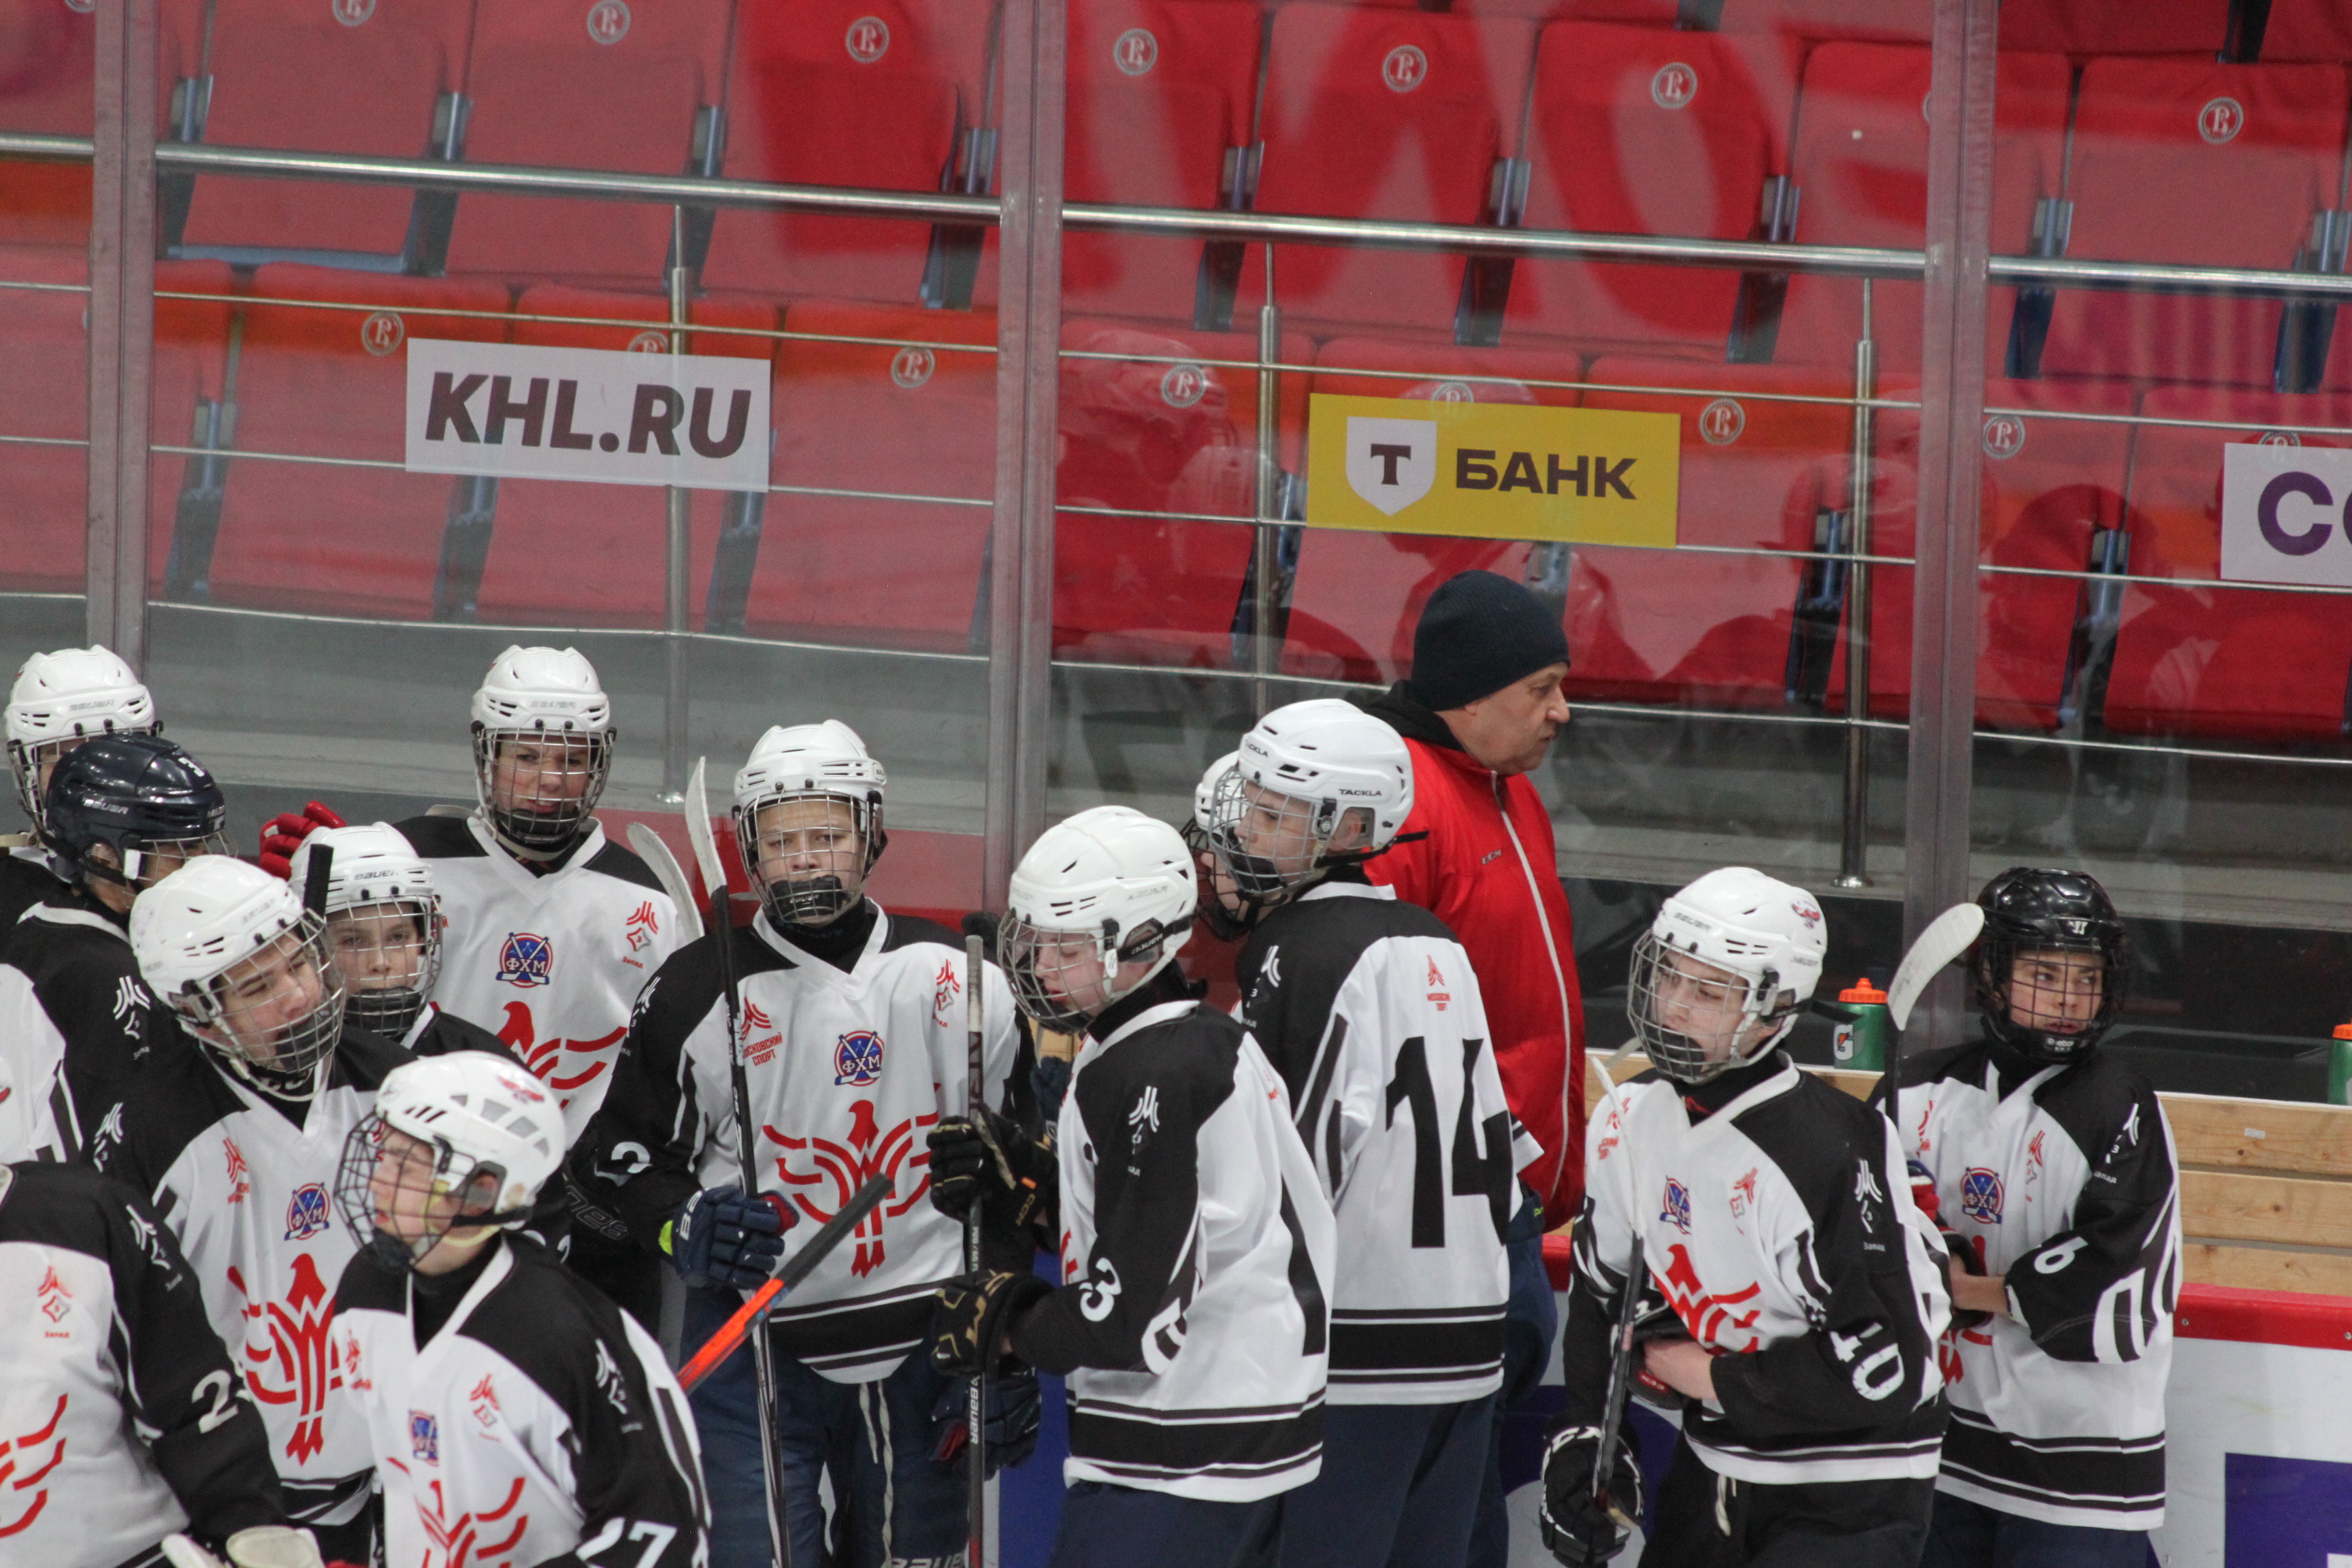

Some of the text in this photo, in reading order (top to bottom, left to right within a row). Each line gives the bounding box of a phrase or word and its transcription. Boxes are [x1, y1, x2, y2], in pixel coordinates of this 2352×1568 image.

[425, 371, 752, 459] KHL.RU
[1455, 447, 1637, 500] БАНК
[1245, 740, 1269, 757] CKLA
[1338, 788, 1382, 796] TACKLA
[506, 957, 546, 973] ФХМ
[743, 1032, 783, 1059] ОСКОВСКИЙ
[752, 1049, 776, 1066] СПОРТ
[842, 1054, 881, 1073] ФХМ
[1386, 1035, 1514, 1250] 14
[191, 1369, 240, 1435] 2
[969, 1386, 979, 1445] BAUER
